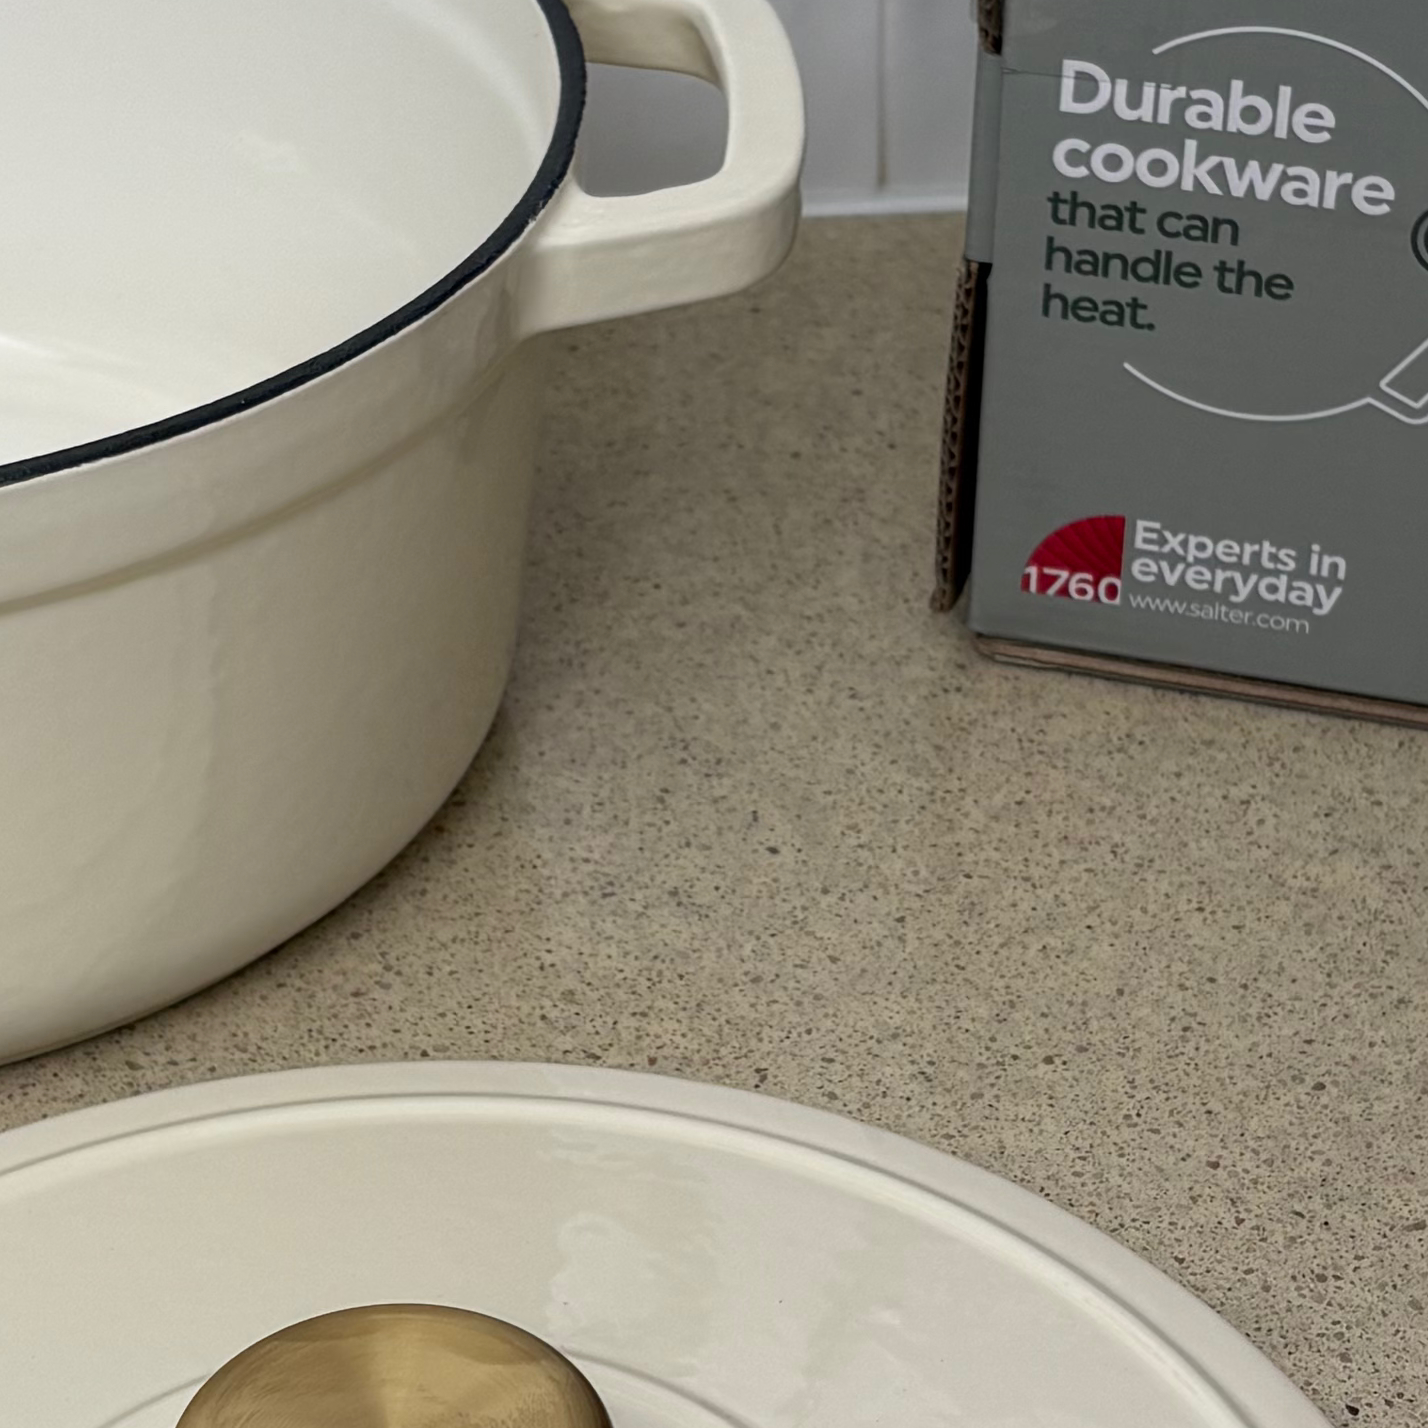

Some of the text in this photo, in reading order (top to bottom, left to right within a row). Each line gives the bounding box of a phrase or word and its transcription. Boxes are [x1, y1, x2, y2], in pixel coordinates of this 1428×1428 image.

[1059, 59, 1336, 144] Durable
[1052, 138, 1396, 216] cookware
[1047, 191, 1240, 246] that can
[1045, 236, 1294, 301] handle the
[1041, 283, 1156, 332] heat.
[1134, 519, 1347, 580] Experts in
[1023, 565, 1121, 605] 1760
[1128, 592, 1310, 634] www.salter.com
[1131, 557, 1342, 616] everyday
